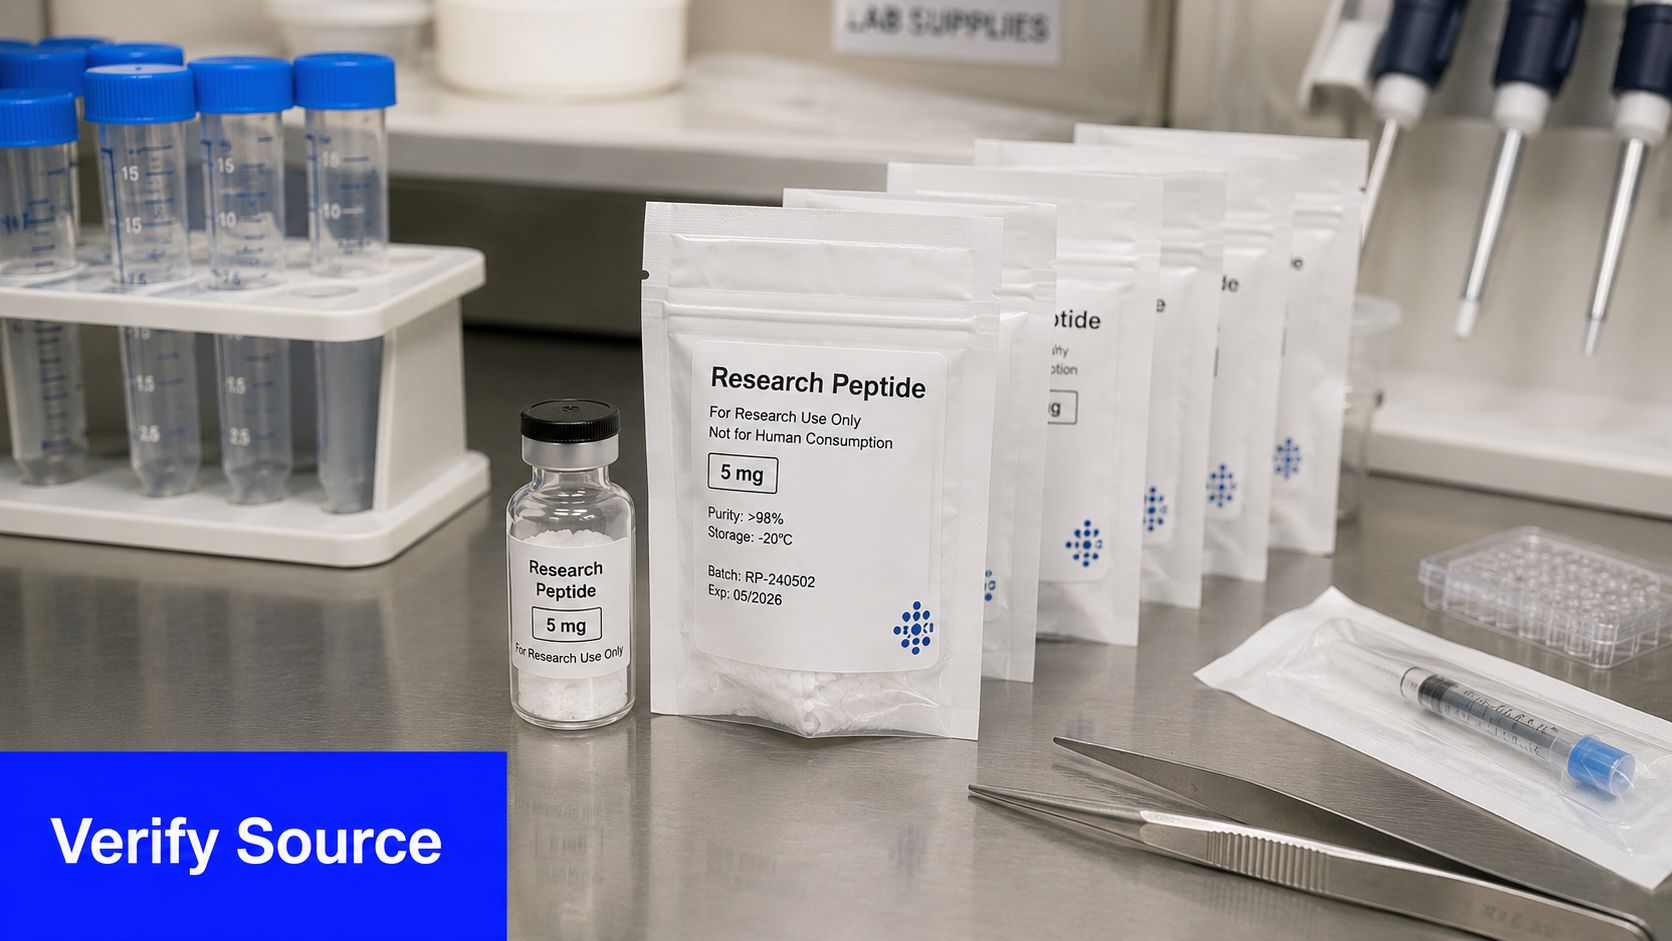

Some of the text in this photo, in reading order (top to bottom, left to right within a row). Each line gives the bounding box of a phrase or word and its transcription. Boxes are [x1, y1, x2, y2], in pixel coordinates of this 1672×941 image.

[908, 6, 1050, 44] SUPPLIES
[122, 165, 140, 182] 15
[125, 217, 142, 234] 15
[711, 365, 926, 401] Research Peptide
[709, 405, 862, 430] For Research Use Only
[708, 426, 893, 450] Not for Human Consumption
[720, 464, 764, 486] 5 mg
[708, 506, 784, 526] Purity: >98%
[707, 525, 754, 544] Storage:
[529, 559, 603, 577] Research
[708, 564, 816, 589] Batch: RP-240502
[536, 582, 597, 602] Peptide
[708, 583, 783, 606] Exp: 05/2026
[546, 617, 587, 636] 5 mg
[515, 642, 624, 664] For Research Use Only
